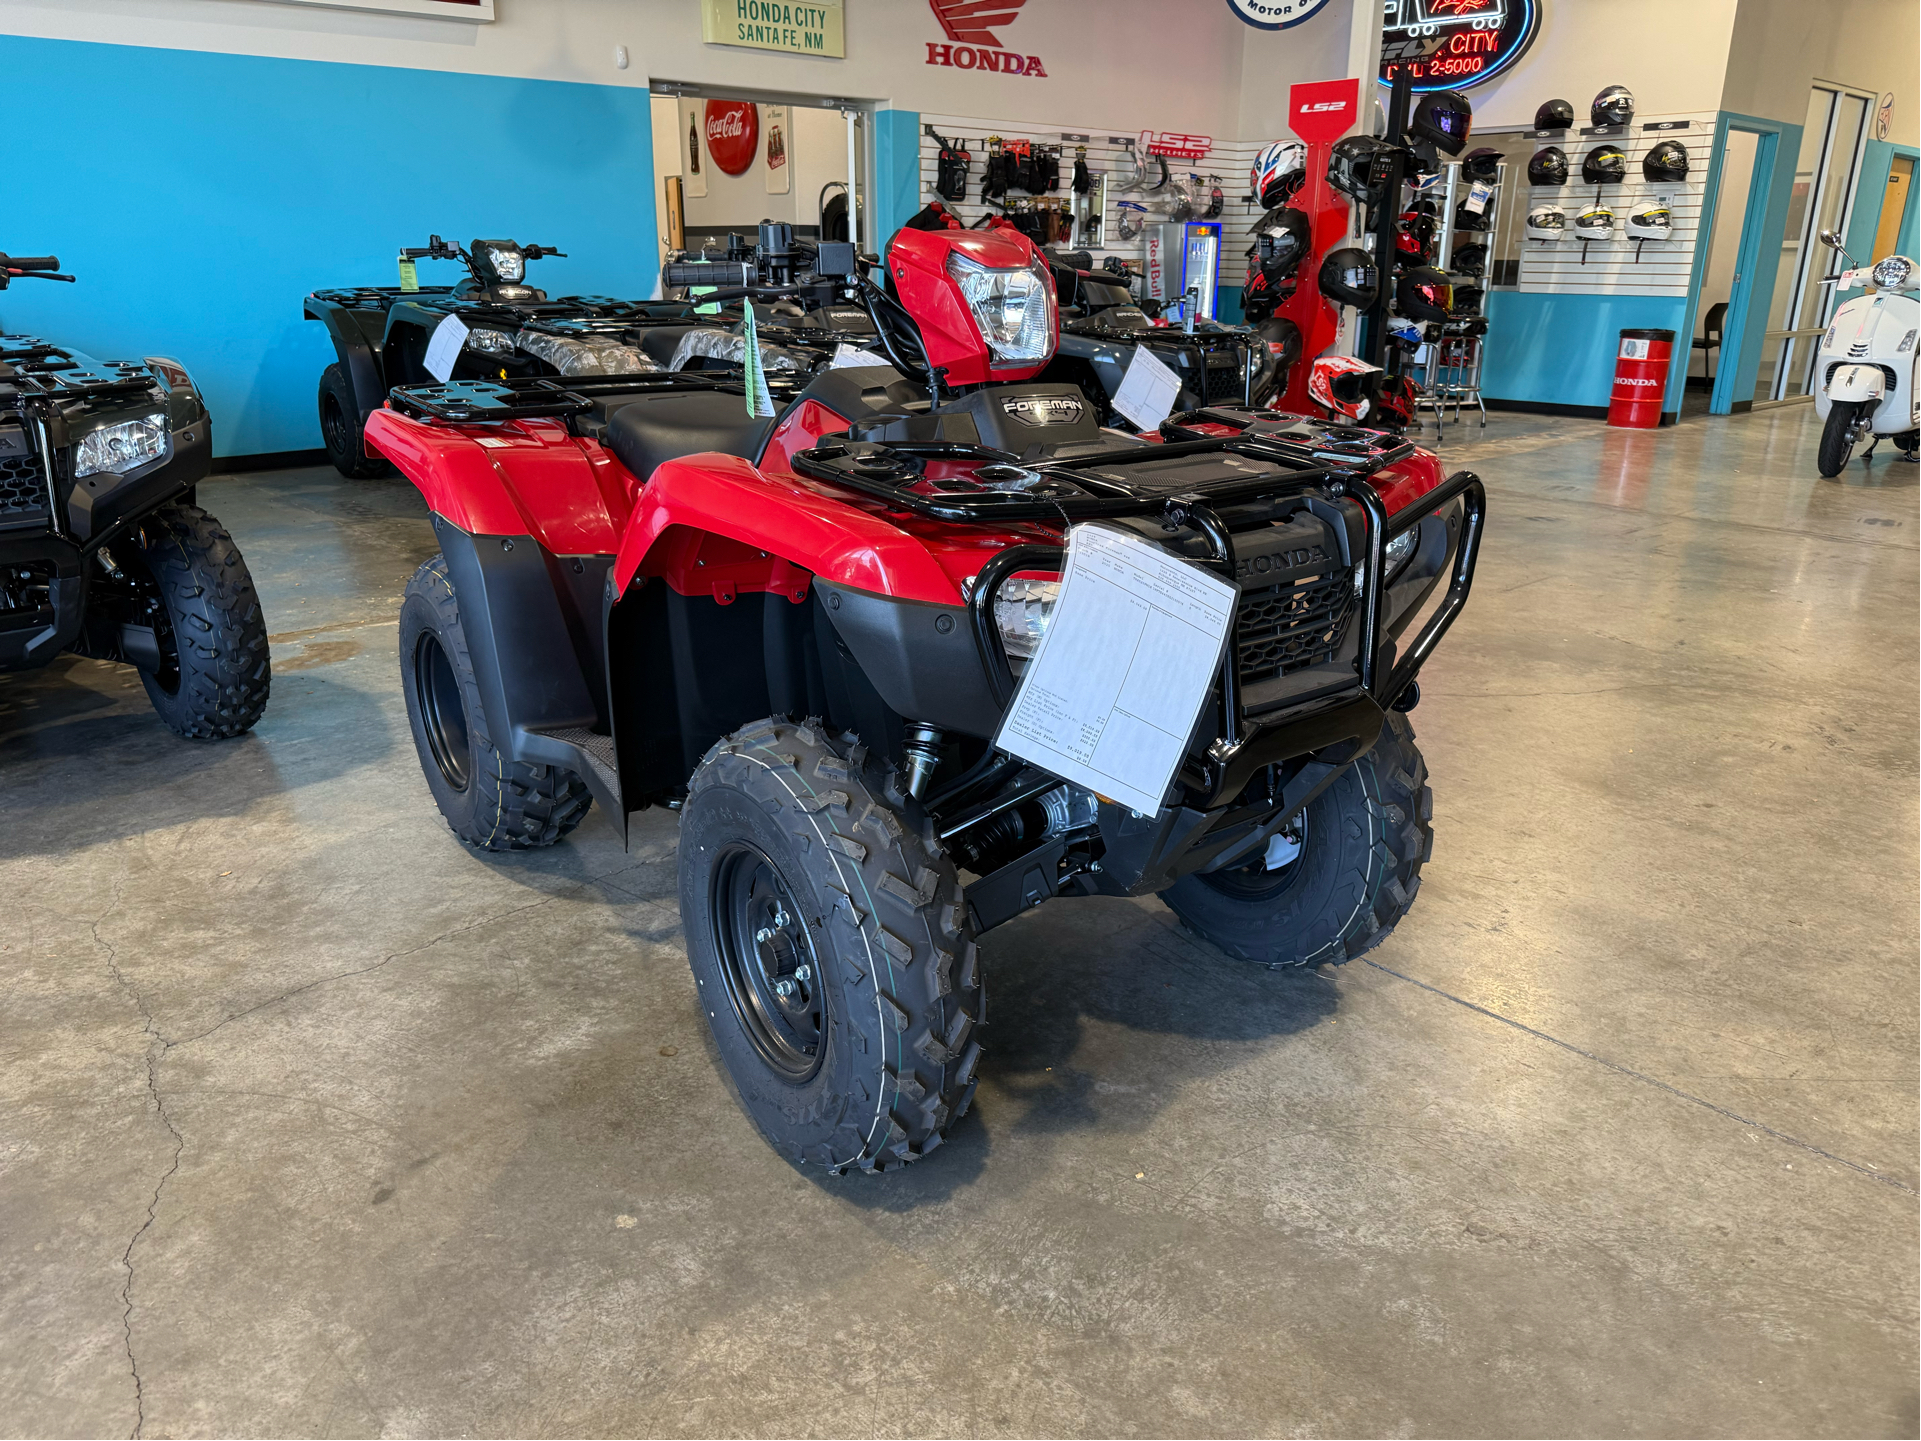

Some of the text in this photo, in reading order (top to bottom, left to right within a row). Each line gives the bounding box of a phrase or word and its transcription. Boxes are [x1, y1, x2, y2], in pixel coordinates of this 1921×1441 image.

[738, 0, 826, 29] HONDA CITY
[1247, 0, 1292, 16] MOTOR
[738, 23, 824, 50] SANTA FE, NM
[1450, 31, 1498, 54] CITY
[925, 42, 1048, 78] HONDA
[1430, 57, 1483, 76] 2-5000
[1300, 101, 1347, 113] LS2
[707, 109, 744, 140] Coca-Cola
[1141, 130, 1212, 151] LS2
[1149, 148, 1203, 158] HELMETS
[1150, 239, 1161, 298] Red Bull
[1614, 376, 1658, 387] HONDA
[1003, 400, 1083, 413] FOREMAN
[1235, 544, 1332, 579] HONDA
